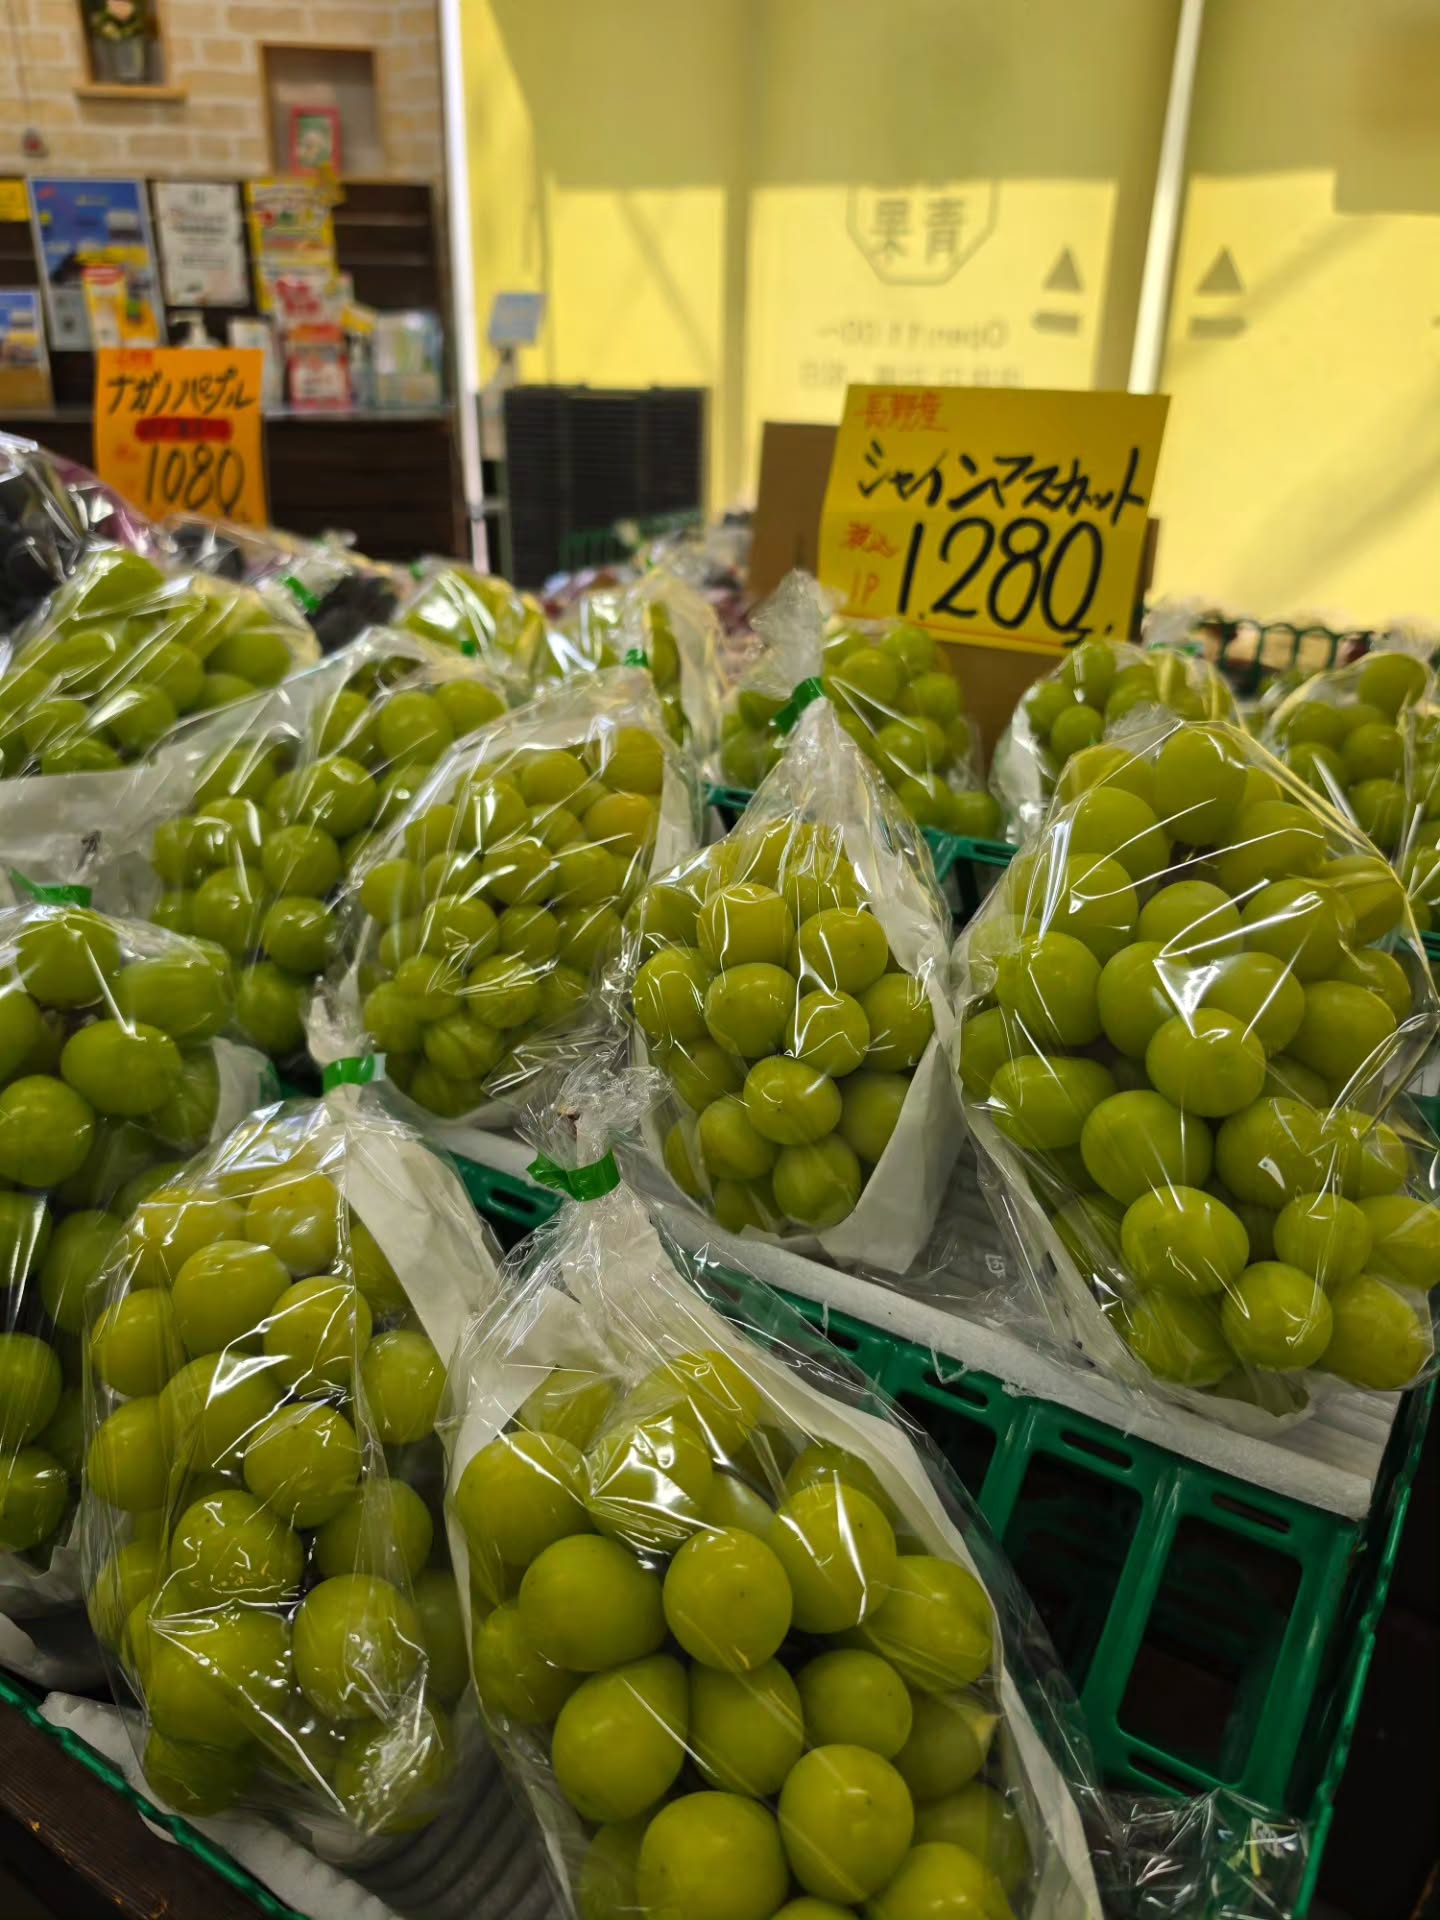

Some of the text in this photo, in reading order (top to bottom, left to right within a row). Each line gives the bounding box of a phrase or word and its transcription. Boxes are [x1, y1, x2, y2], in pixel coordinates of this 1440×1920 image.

[857, 440, 1147, 526] シャインマスカット
